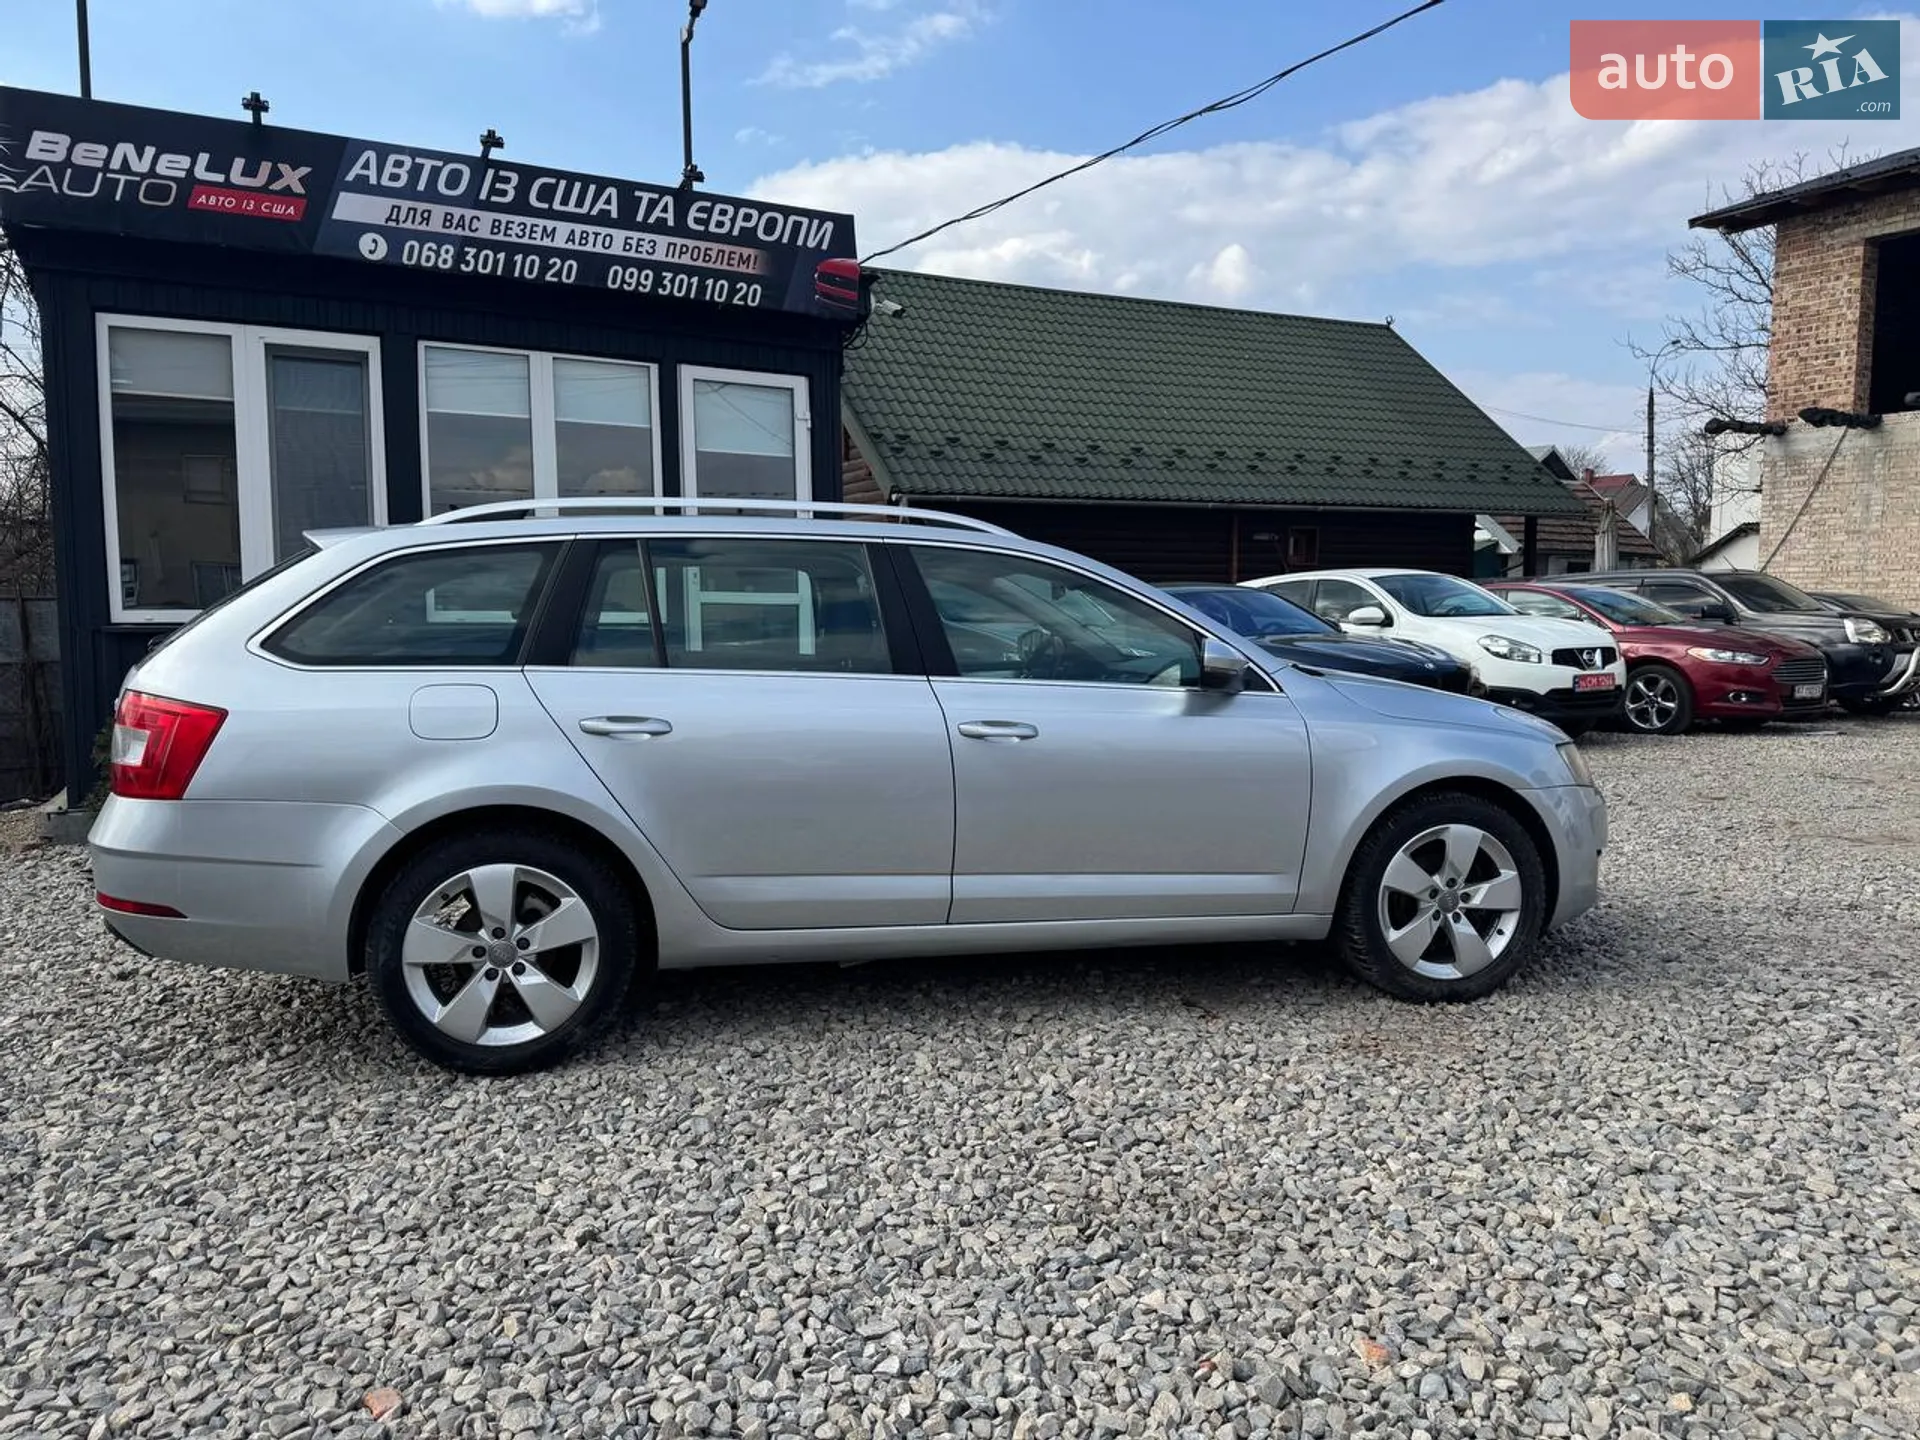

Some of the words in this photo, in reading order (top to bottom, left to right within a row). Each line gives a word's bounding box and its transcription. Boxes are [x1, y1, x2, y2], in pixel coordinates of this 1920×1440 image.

[18, 165, 177, 206] AUTO
[197, 194, 235, 208] АВТО
[242, 198, 255, 210] ІЗ
[261, 202, 296, 216] США
[345, 150, 471, 196] АВТО
[479, 168, 519, 204] ІЗ
[528, 176, 618, 219] США
[634, 190, 675, 227] ТА
[686, 200, 834, 250] ЄВРОПИ
[384, 205, 432, 227] ДЛЯ
[442, 213, 481, 233] ВАС
[490, 220, 556, 243] ВЕЗЕМ
[565, 229, 613, 250] АВТО
[622, 236, 657, 256] БЕЗ
[664, 242, 759, 270] ПРОБЛЕМ!
[402, 240, 454, 269] 068
[460, 247, 503, 276] 301
[513, 254, 540, 279] 10
[545, 259, 578, 284] 20
[607, 265, 654, 293] 099
[657, 272, 698, 300] 301
[704, 277, 729, 303] 10
[733, 281, 762, 308] 20
